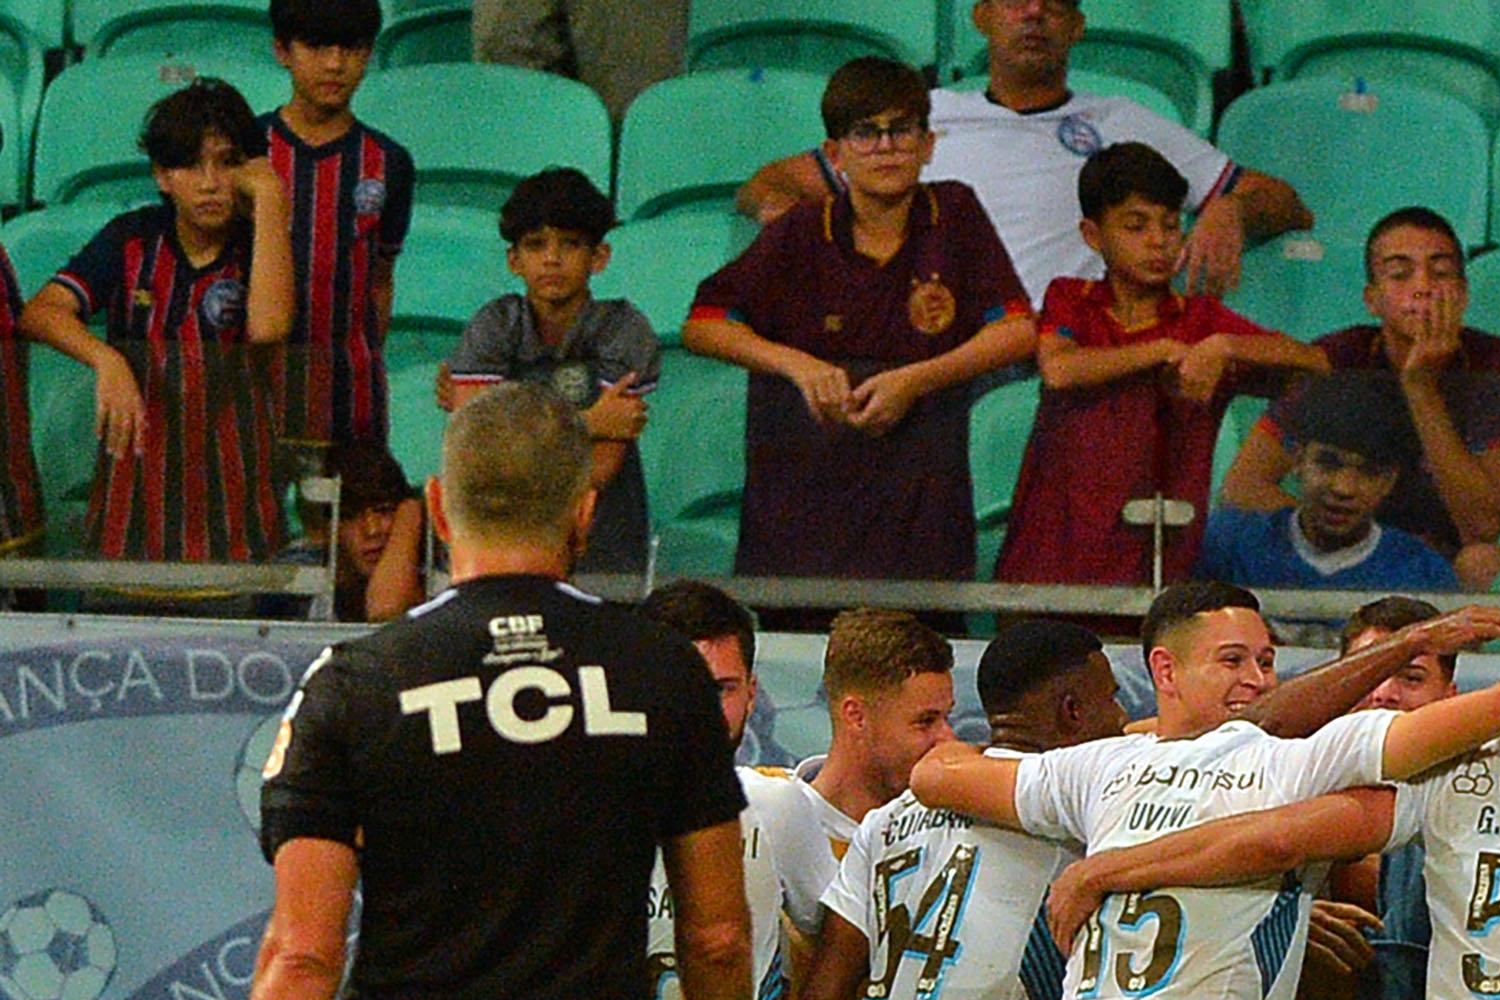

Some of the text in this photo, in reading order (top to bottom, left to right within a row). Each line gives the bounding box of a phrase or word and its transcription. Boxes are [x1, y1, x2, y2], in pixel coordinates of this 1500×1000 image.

[188, 649, 293, 702] DO
[400, 664, 648, 755] TCL
[1477, 805, 1500, 835] G.
